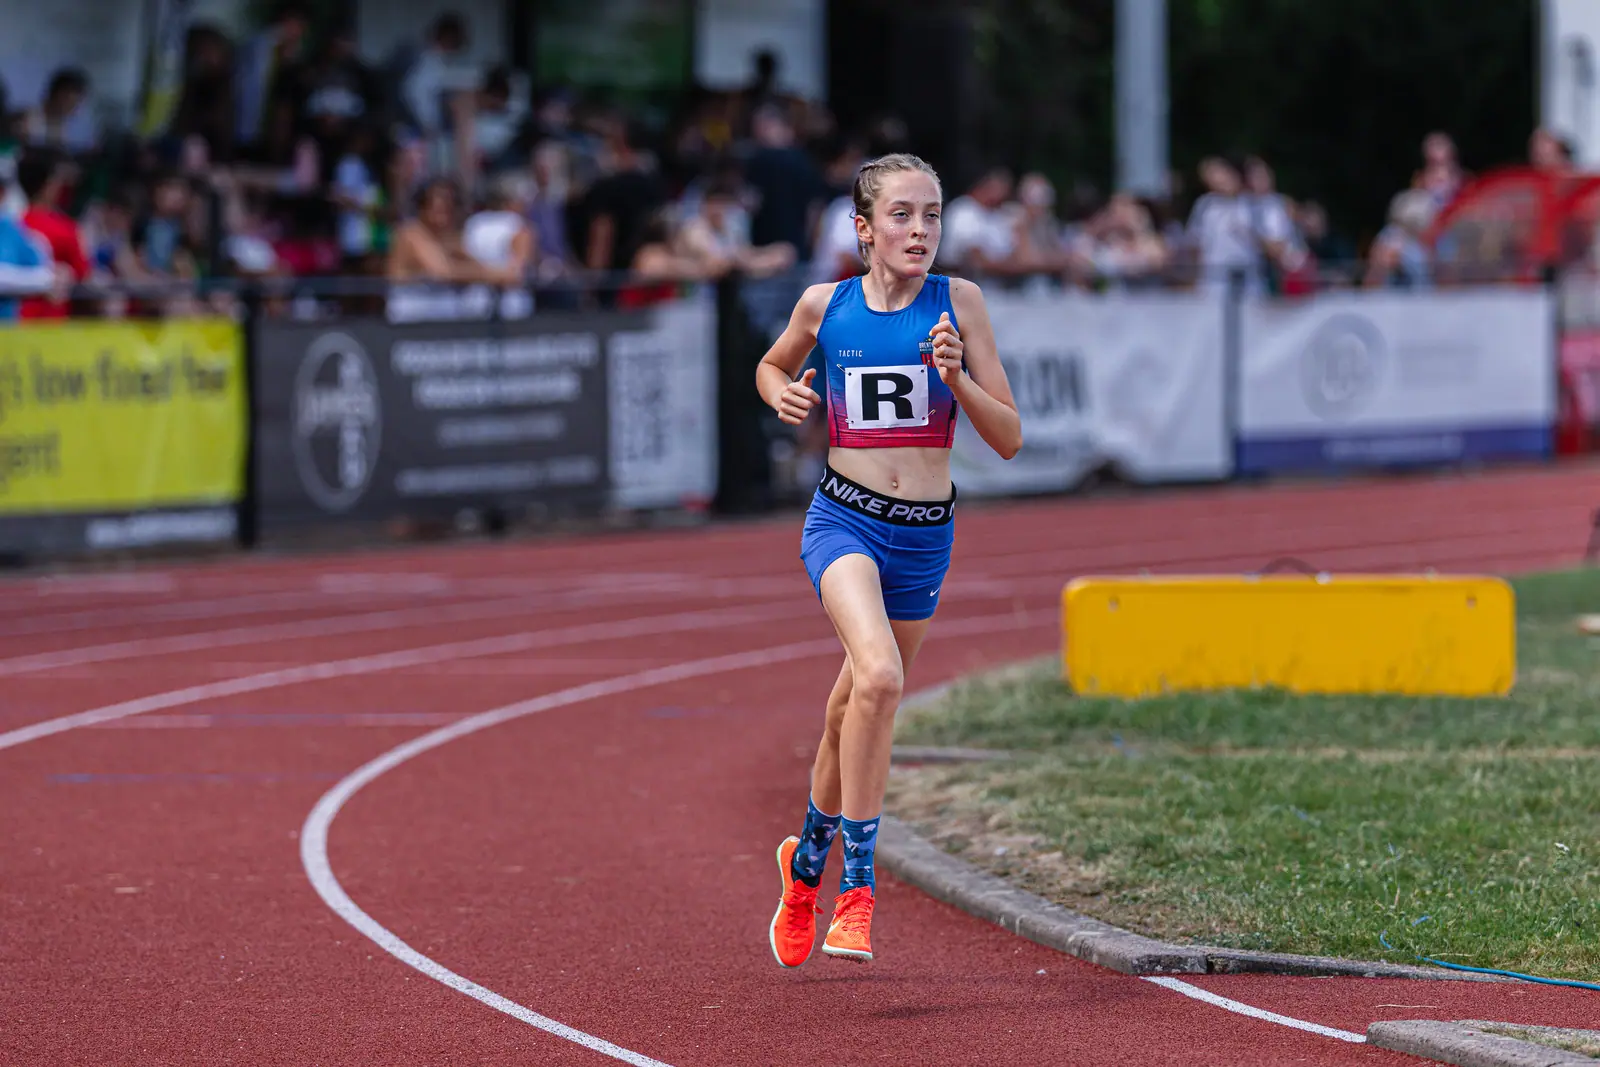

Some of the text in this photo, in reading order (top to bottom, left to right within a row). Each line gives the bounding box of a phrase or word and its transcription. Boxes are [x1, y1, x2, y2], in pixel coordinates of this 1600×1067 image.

[838, 349, 863, 358] TACTIC
[861, 372, 915, 421] R
[825, 477, 888, 514] NIKE
[887, 504, 945, 522] PRO
